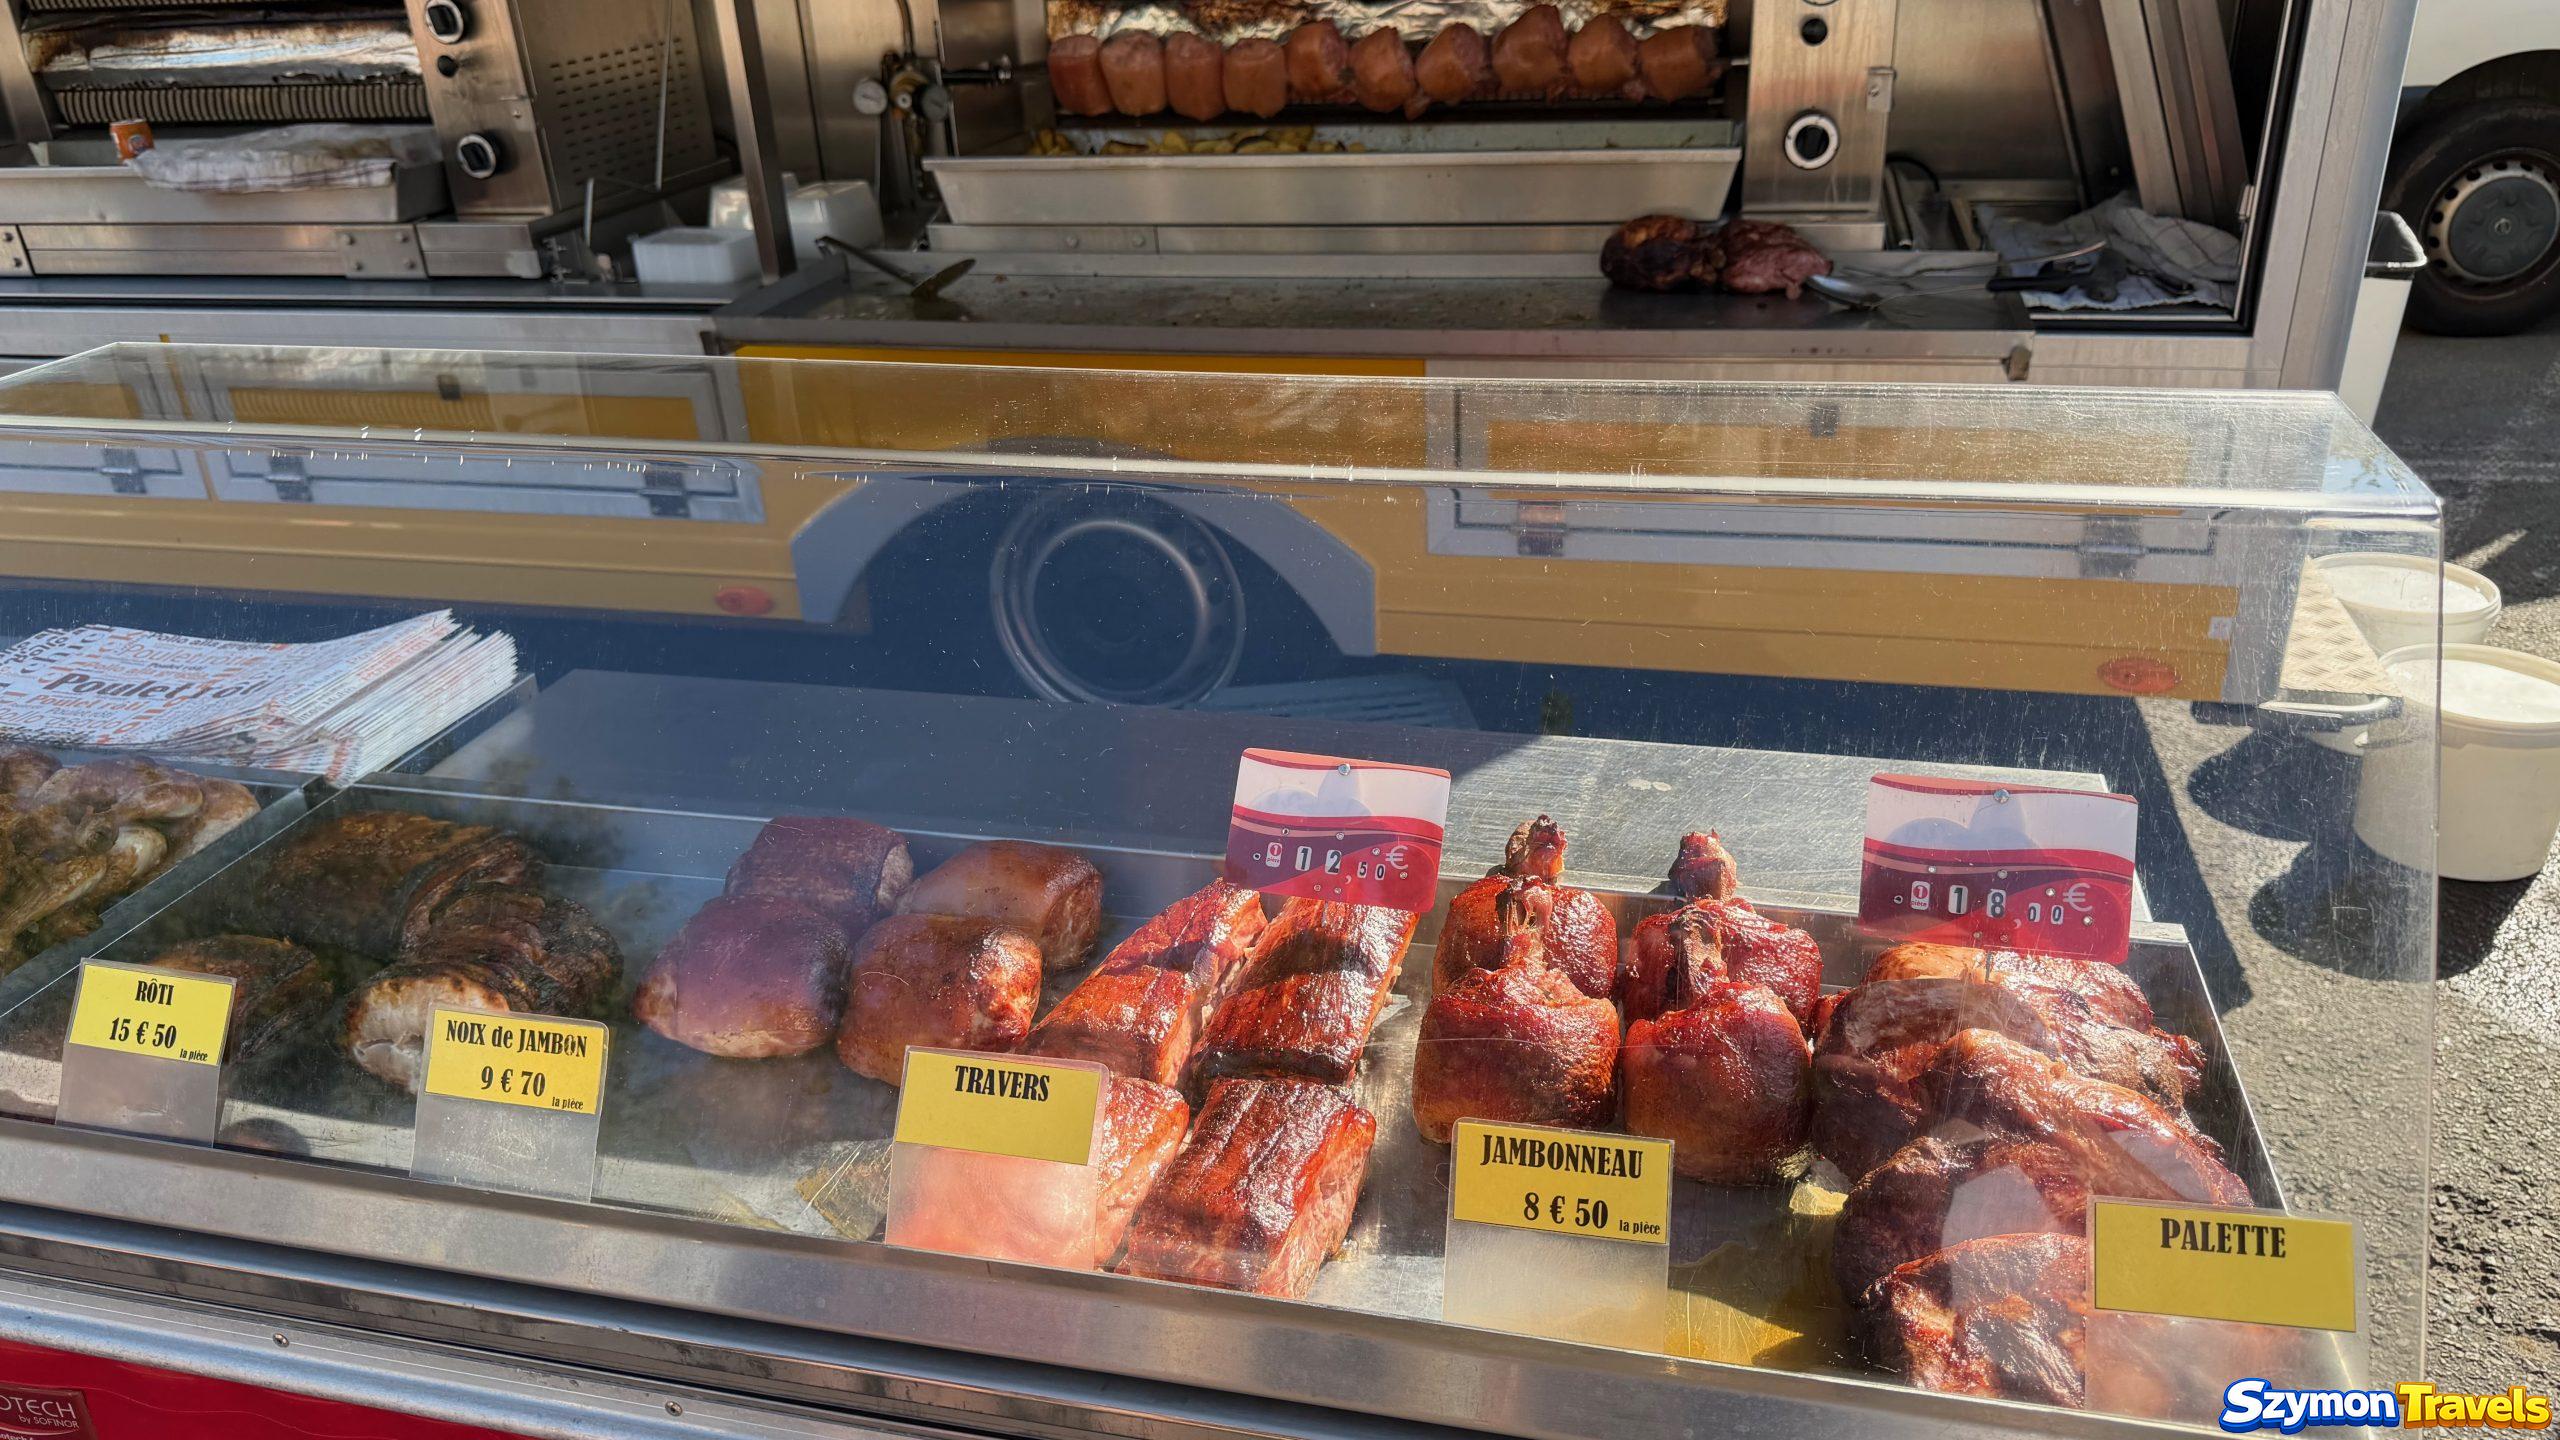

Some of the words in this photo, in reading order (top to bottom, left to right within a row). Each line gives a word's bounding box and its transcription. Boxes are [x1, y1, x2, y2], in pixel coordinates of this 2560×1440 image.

[42, 673, 194, 699] Poulet
[135, 978, 174, 1006] RÔTI
[109, 1017, 131, 1042] 15
[136, 1021, 149, 1045] €
[152, 1023, 177, 1049] 50
[446, 1019, 487, 1046] NOIX
[491, 1026, 513, 1049] de
[517, 1028, 588, 1058] JAMBON
[179, 1048, 189, 1060] la
[188, 1051, 208, 1062] pièce
[481, 1066, 494, 1090] 9
[500, 1068, 513, 1093] €
[521, 1071, 546, 1097] 70
[955, 1065, 1050, 1102] TRAVERS
[551, 1096, 560, 1108] la
[562, 1098, 584, 1110] pièce
[1480, 1134, 1643, 1179] JAMBONNEAU
[1523, 1191, 1540, 1221] 8
[1550, 1195, 1566, 1224] €
[1575, 1198, 1609, 1229] 50
[1619, 1219, 1630, 1232] la
[1632, 1221, 1661, 1235] pièce
[2160, 1217, 2287, 1258] PALETTE
[18, 1415, 31, 1425] by
[33, 1416, 80, 1429] SOFINOR
